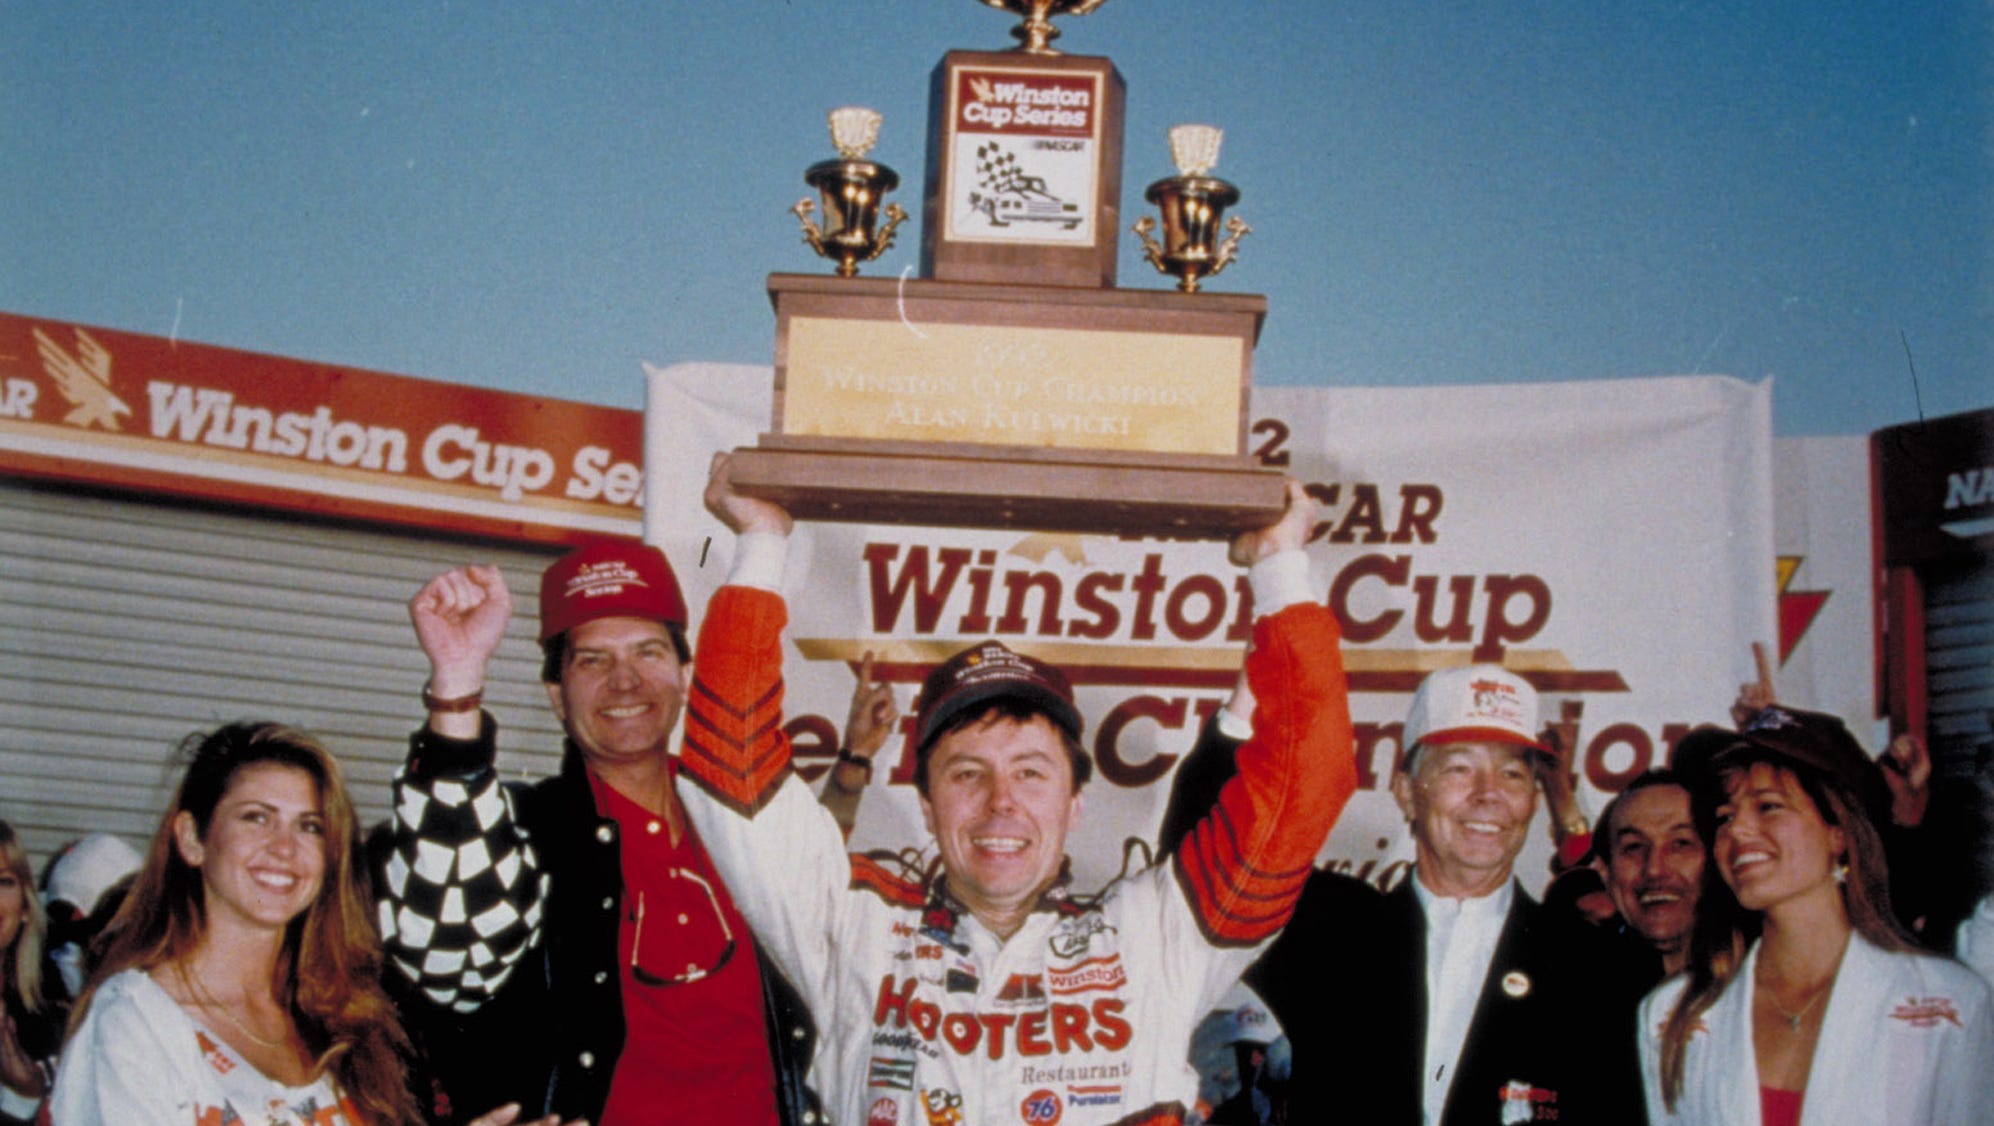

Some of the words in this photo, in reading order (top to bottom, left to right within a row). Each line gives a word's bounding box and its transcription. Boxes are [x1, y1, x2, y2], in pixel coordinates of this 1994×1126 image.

[994, 83, 1090, 106] Winston
[963, 102, 1013, 128] Cup
[1013, 104, 1087, 127] Series
[885, 402, 969, 429] ALAN
[148, 381, 408, 473] Winston
[422, 425, 555, 500] Cup
[566, 446, 645, 506] Se
[1328, 553, 1553, 663] Cup
[873, 973, 1133, 1060] HOOTERS
[1021, 1060, 1132, 1084] Restaurant
[1028, 1097, 1056, 1119] 76
